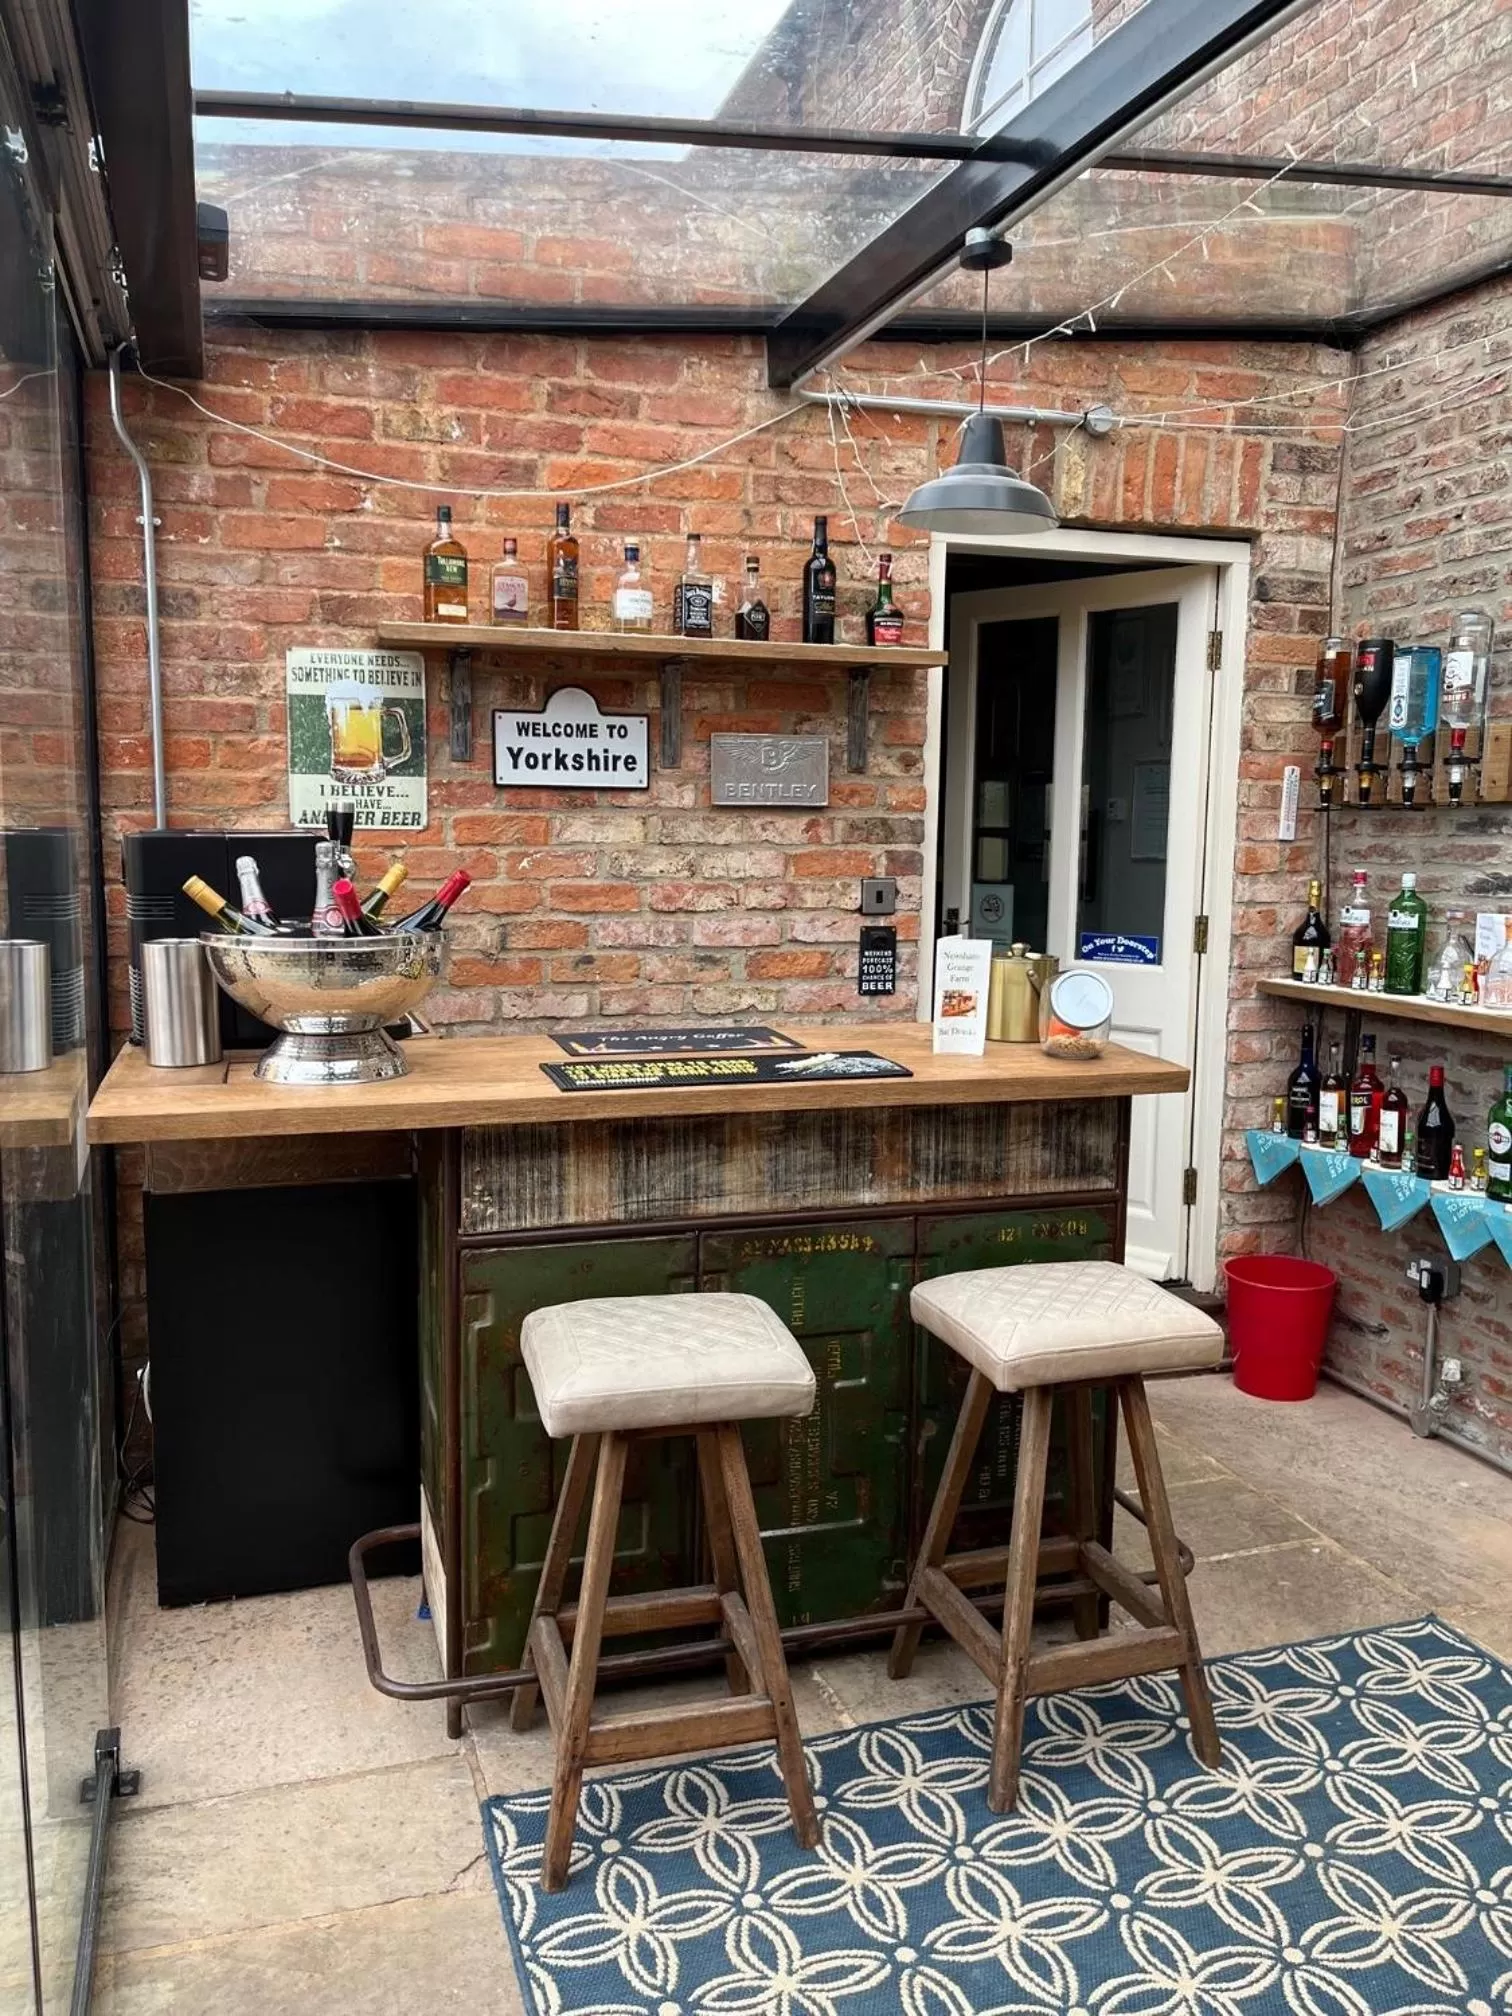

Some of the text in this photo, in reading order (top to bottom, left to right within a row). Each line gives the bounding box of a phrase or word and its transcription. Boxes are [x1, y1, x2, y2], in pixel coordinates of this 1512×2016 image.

[310, 653, 410, 667] EVERYONE NEEDS...
[353, 669, 365, 684] TO
[368, 669, 408, 686] BELIEVE
[411, 671, 422, 687] IN
[516, 721, 628, 739] WELCOME TO
[506, 746, 637, 772] Yorkshire
[320, 784, 409, 798] I BELIEVE...
[725, 783, 817, 798] BENTLEY
[380, 811, 422, 826] BEER
[1082, 943, 1094, 953] On
[1094, 937, 1116, 947] Your
[1117, 936, 1155, 959] Doorstep
[862, 964, 893, 974] 100%
[862, 981, 893, 991] BEER
[635, 1033, 687, 1041] Angry
